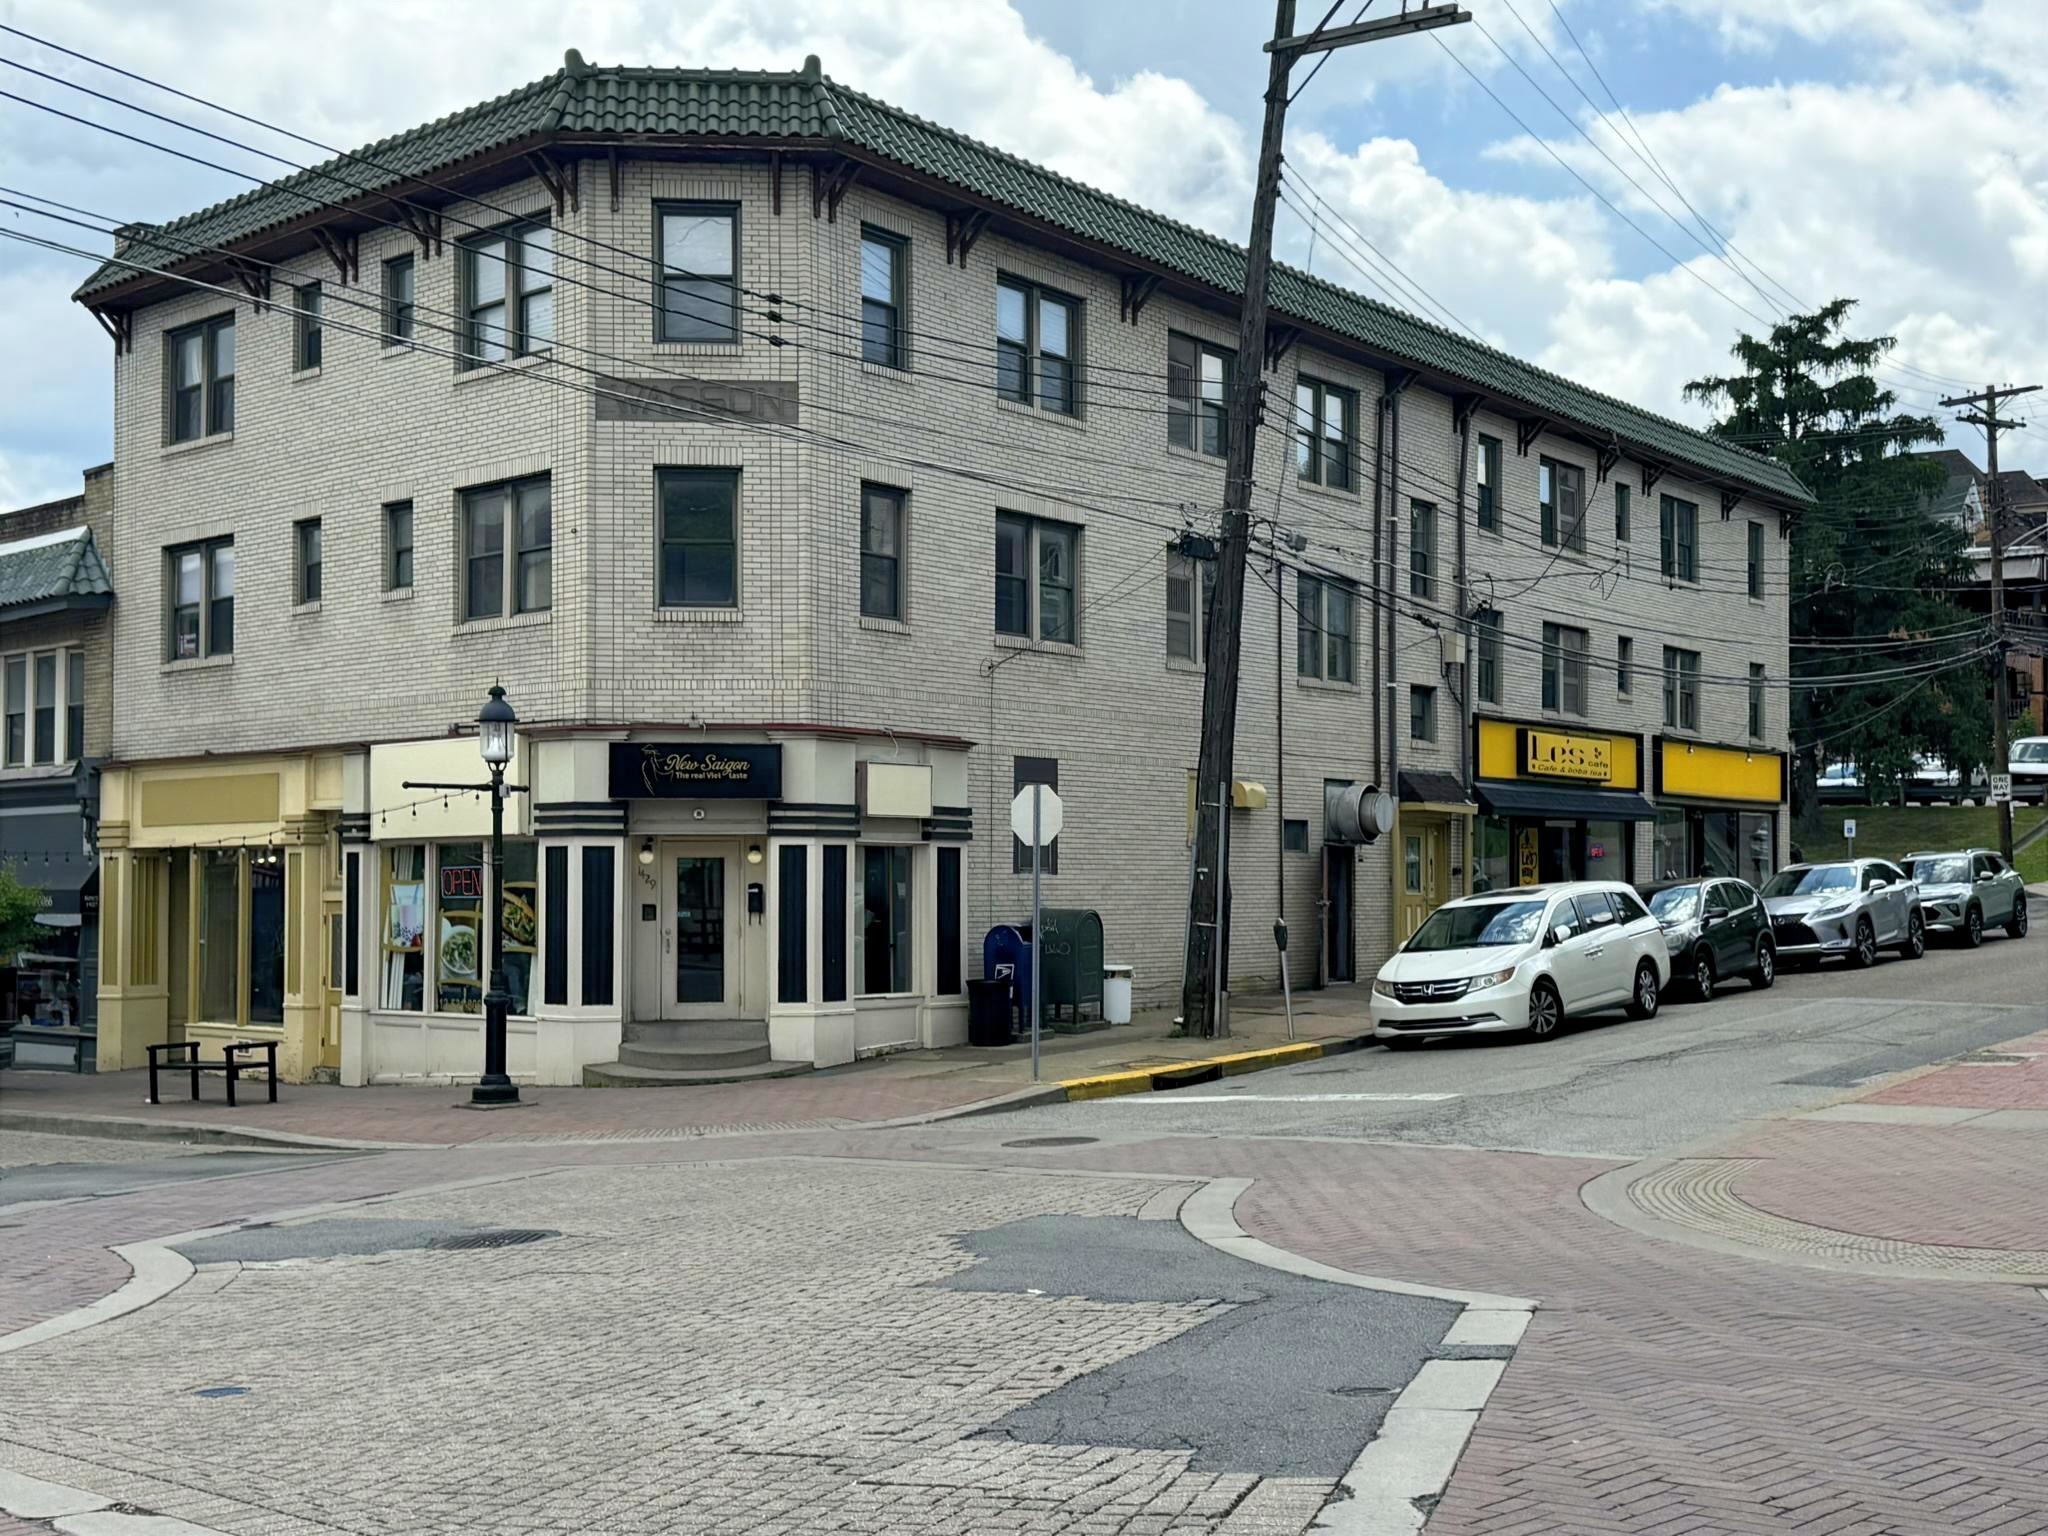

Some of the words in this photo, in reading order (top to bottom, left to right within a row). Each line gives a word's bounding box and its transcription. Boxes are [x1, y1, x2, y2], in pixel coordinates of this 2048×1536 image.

[664, 754, 699, 770] New
[701, 754, 750, 776] Saigon
[1538, 764, 1557, 772] Cafe
[443, 868, 482, 896] OPEN
[638, 865, 656, 890] 1429
